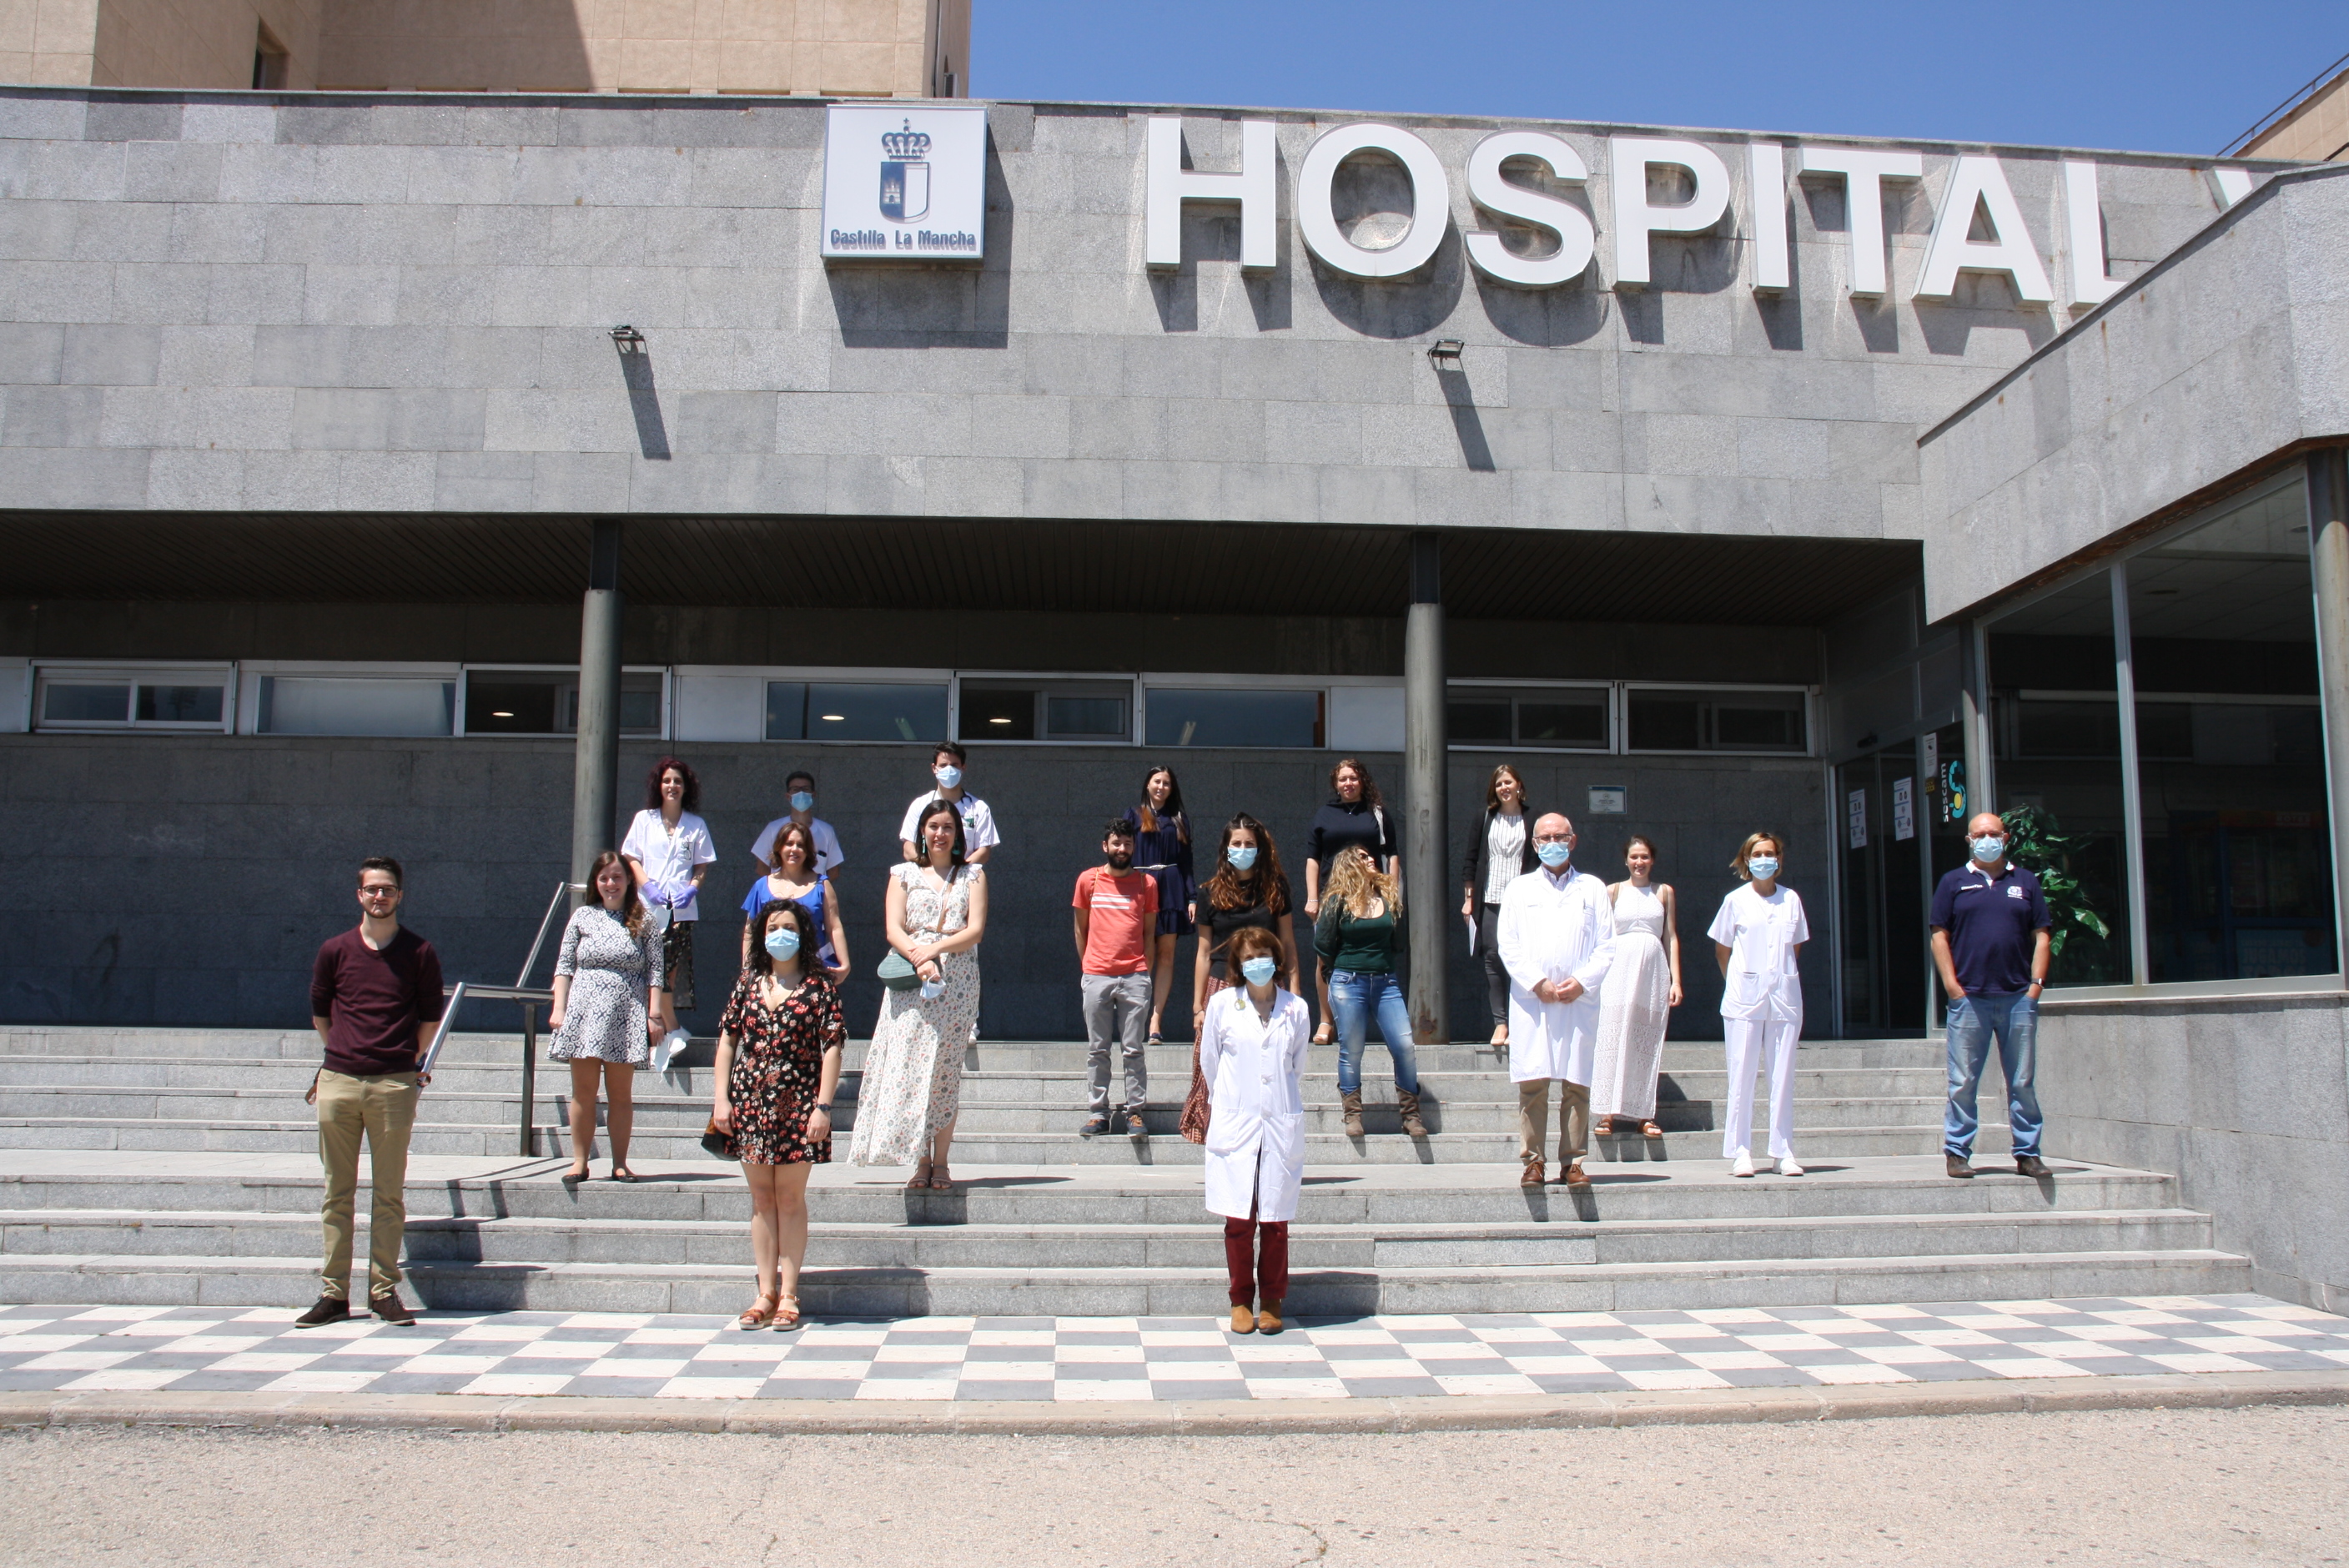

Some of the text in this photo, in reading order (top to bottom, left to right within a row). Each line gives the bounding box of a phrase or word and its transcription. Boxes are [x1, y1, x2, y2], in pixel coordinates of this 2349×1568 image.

[830, 229, 975, 248] Castilla La Mancha
[1146, 114, 2129, 304] HOSPITAL
[1940, 762, 1949, 823] sescam
